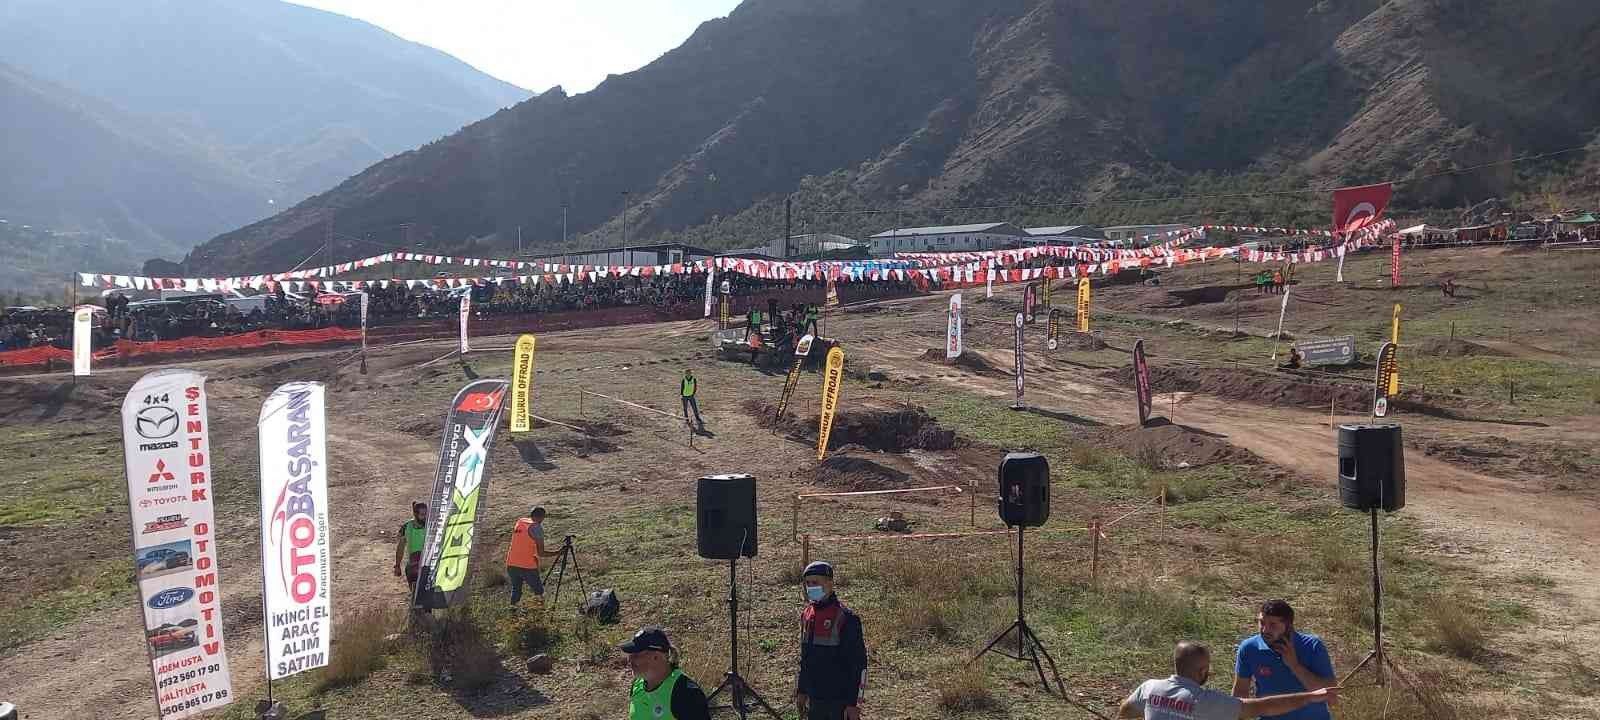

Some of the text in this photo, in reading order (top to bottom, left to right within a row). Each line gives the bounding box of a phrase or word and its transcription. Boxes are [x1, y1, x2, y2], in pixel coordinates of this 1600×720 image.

[519, 352, 530, 389] OFFROAD
[143, 393, 170, 405] 4x4
[825, 368, 838, 411] OFFROAD
[139, 441, 179, 452] mazda
[185, 386, 208, 502] ŞENTÜRK
[153, 495, 188, 505] TOYOTA
[157, 588, 186, 608] Ford
[193, 522, 220, 656] OTOMOTİV
[271, 605, 329, 627] İKİNCİ EL
[281, 621, 320, 641] ARAÇ
[282, 636, 320, 657] ALIM
[157, 655, 204, 676] ADEM USTA
[179, 670, 196, 682] 560
[197, 667, 206, 676] 17
[207, 663, 220, 674] 90
[277, 652, 324, 676] SATIM
[185, 682, 207, 695] USTA
[201, 693, 214, 704] 07
[215, 689, 228, 700] 89
